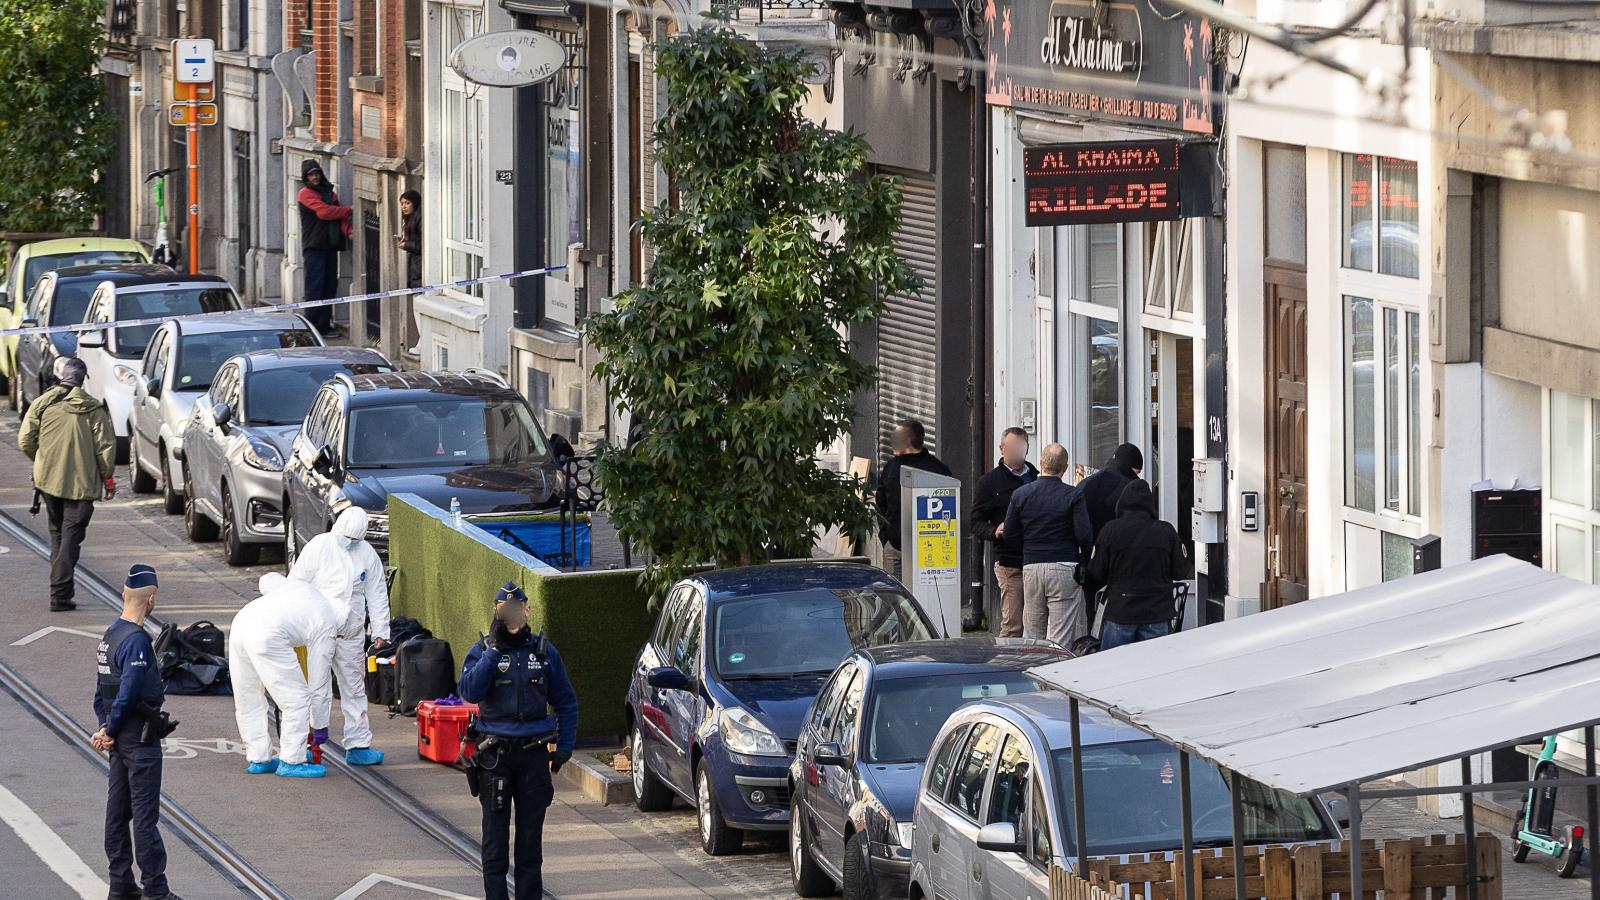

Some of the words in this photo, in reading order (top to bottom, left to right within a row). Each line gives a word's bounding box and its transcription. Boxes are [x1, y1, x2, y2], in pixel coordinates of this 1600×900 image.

[192, 45, 198, 54] 1
[1064, 16, 1124, 73] Khaima
[192, 68, 199, 77] 2
[1041, 152, 1070, 169] AL
[1077, 148, 1161, 168] KHAIMA
[499, 173, 512, 181] 23
[1208, 415, 1222, 443] 13A
[927, 497, 943, 519] P
